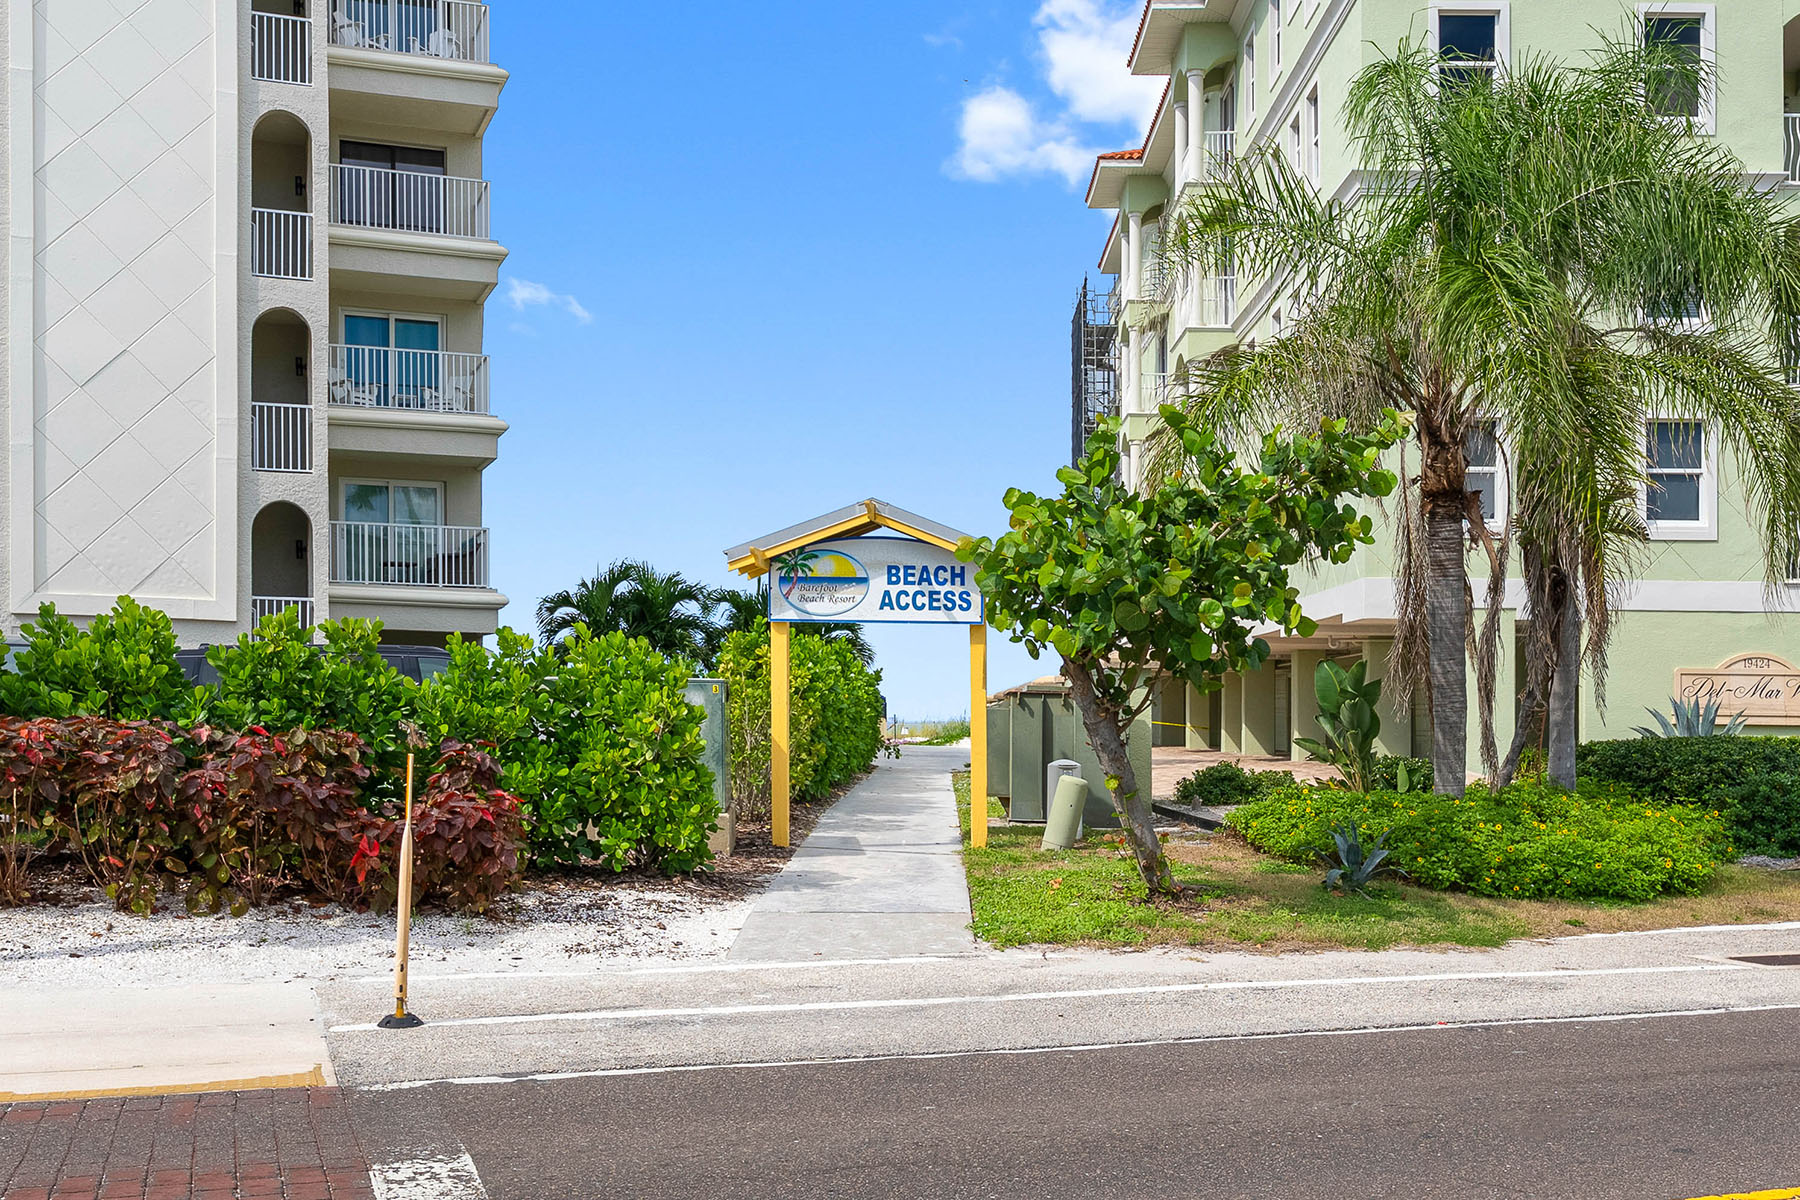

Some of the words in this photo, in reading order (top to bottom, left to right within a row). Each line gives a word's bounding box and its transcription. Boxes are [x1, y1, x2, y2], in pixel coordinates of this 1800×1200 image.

[887, 565, 965, 585] BEACH
[797, 582, 838, 595] Barefoot
[797, 592, 825, 603] Beach
[827, 594, 856, 605] Resort
[879, 590, 972, 611] ACCESS
[1743, 658, 1770, 669] 19424
